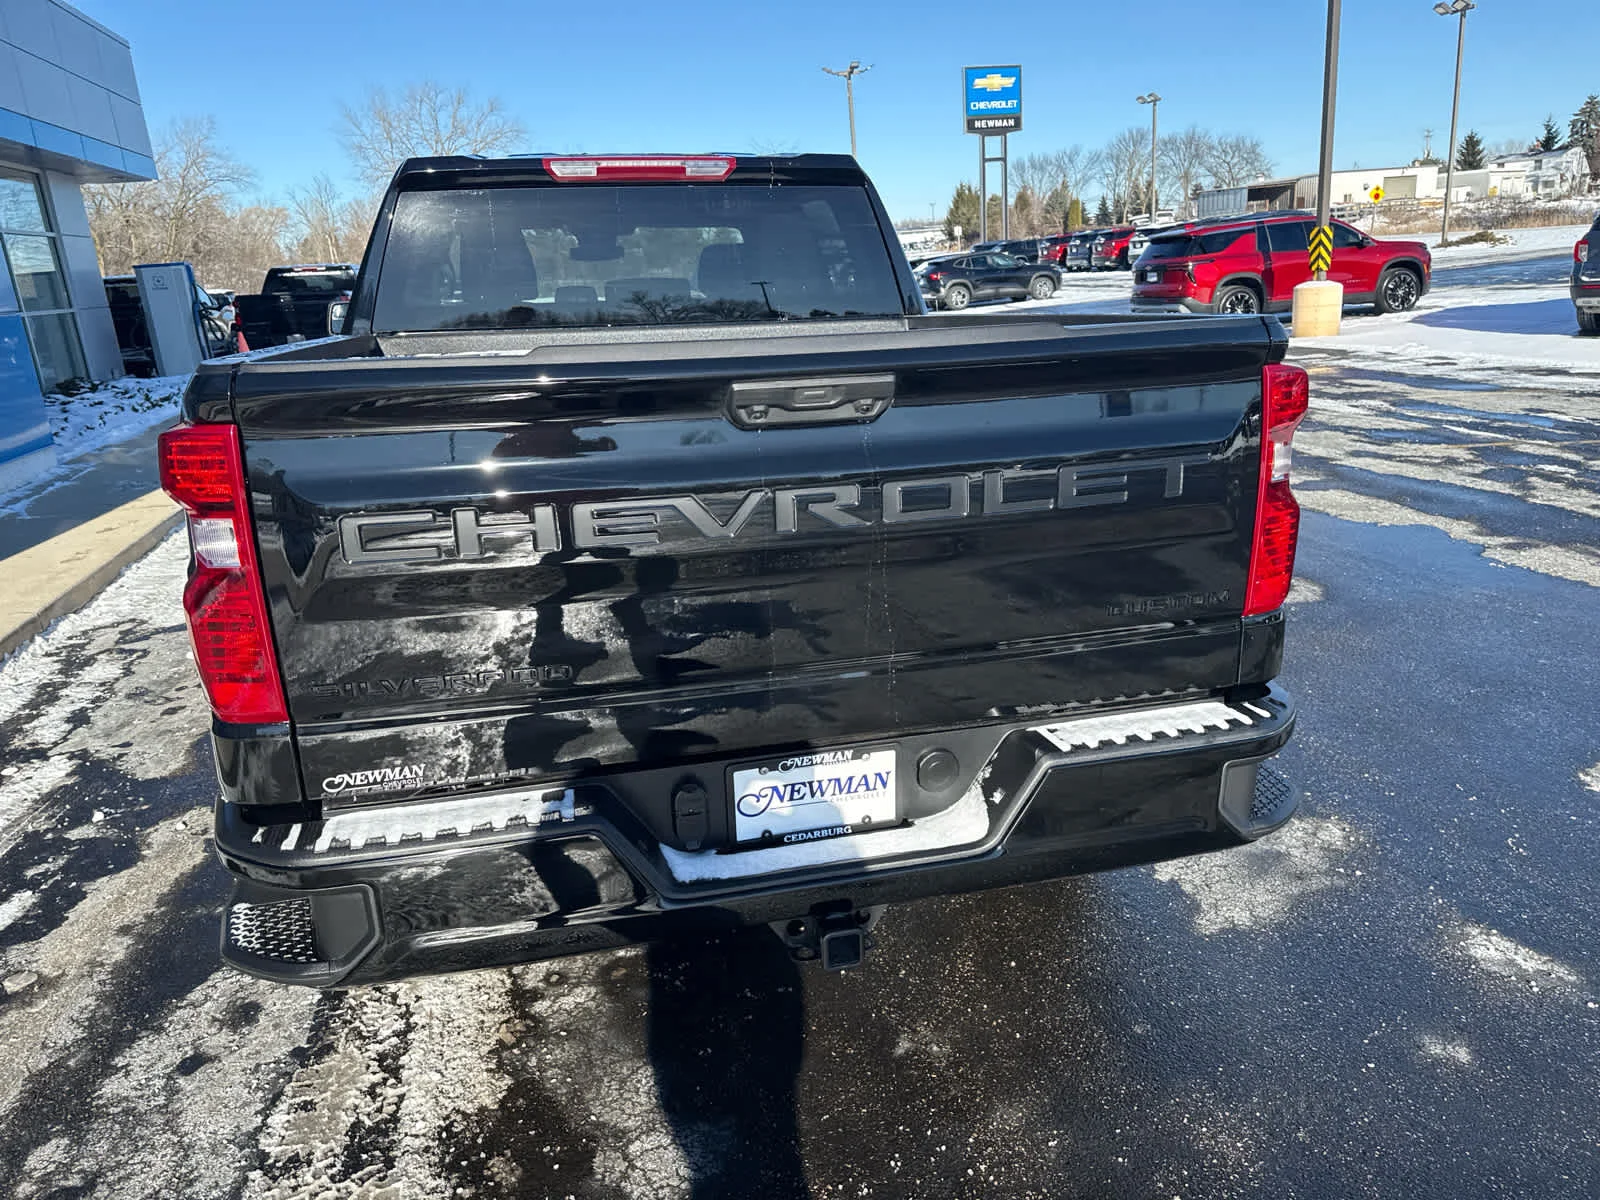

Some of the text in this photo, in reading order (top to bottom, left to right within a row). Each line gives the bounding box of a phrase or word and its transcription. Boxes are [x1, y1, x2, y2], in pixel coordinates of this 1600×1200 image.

[970, 99, 1018, 110] CHEVROLET
[974, 118, 1015, 128] NEWMAN
[338, 456, 1188, 564] CHEVROLET
[311, 665, 573, 696] SILVERADO
[778, 750, 854, 772] NEWMAN
[322, 764, 426, 793] NEWMAN
[383, 777, 424, 788] CHEVROLET
[737, 771, 891, 817] NEWMAN
[784, 826, 852, 843] CEDARBURG
